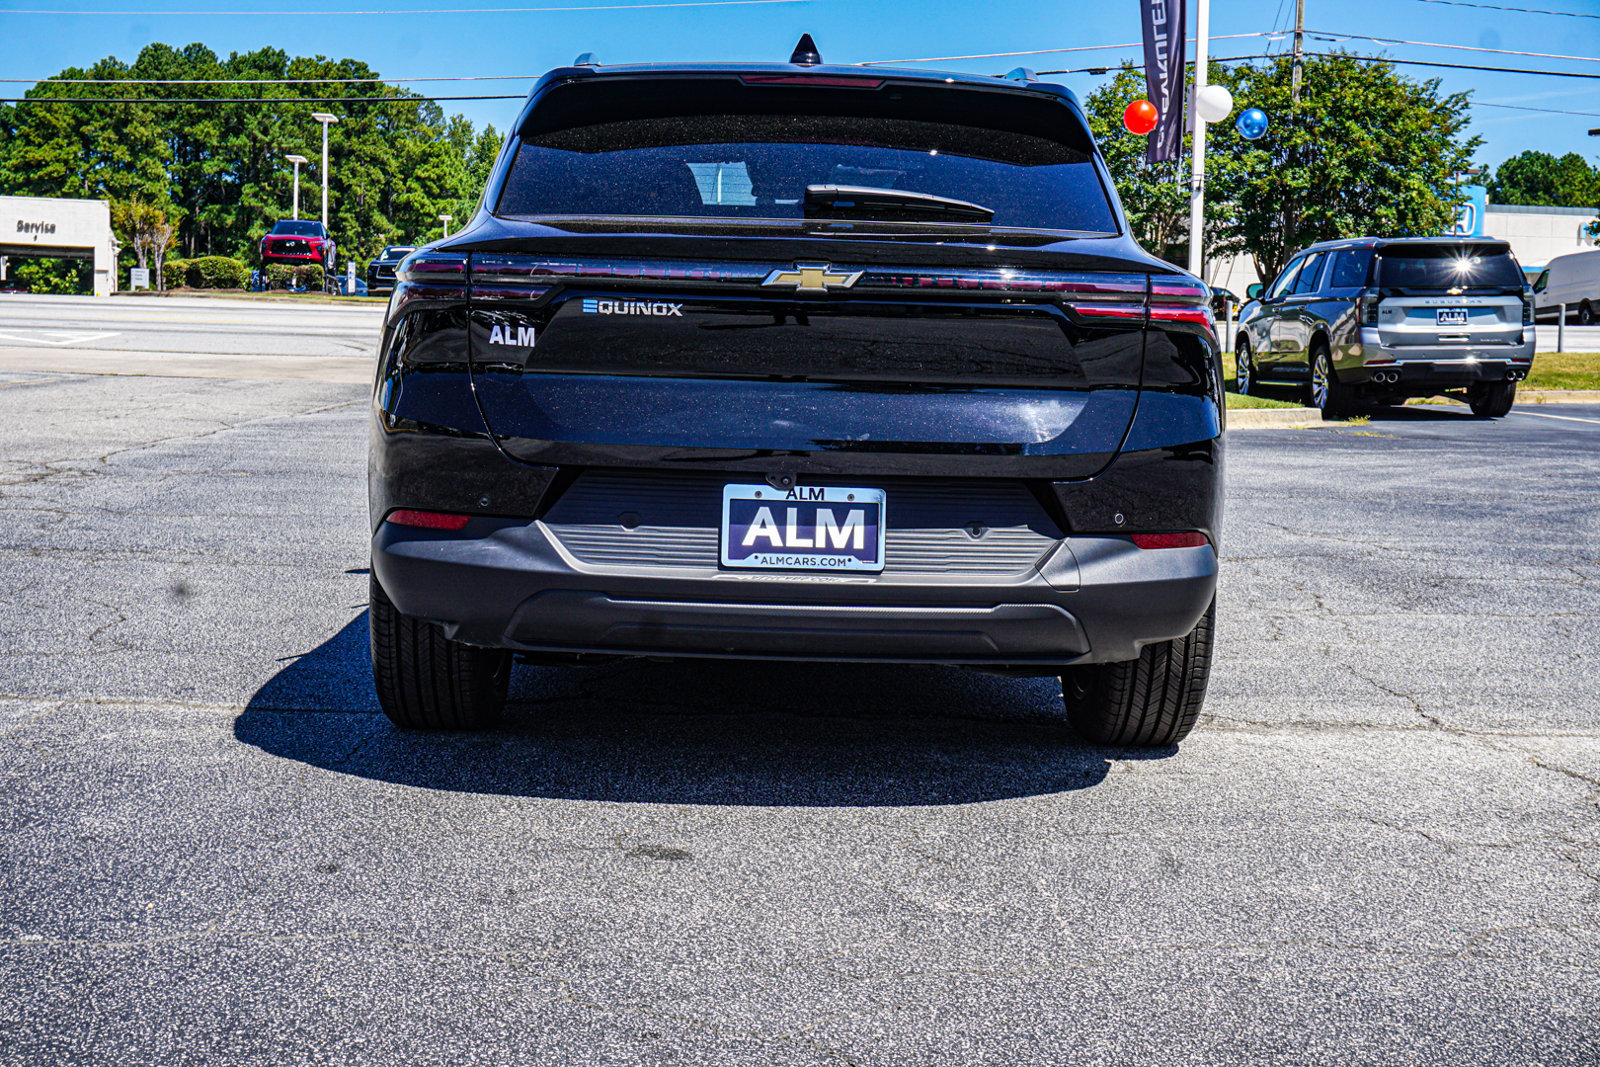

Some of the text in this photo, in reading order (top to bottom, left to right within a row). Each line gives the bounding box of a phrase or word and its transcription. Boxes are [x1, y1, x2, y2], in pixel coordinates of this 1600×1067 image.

[16, 219, 57, 235] Service
[582, 298, 684, 318] EQUINOX
[1440, 312, 1465, 322] ALM
[488, 324, 536, 348] ALM
[785, 487, 825, 501] ALM
[741, 506, 865, 550] ALM
[760, 555, 847, 568] ALMCARS.COM
